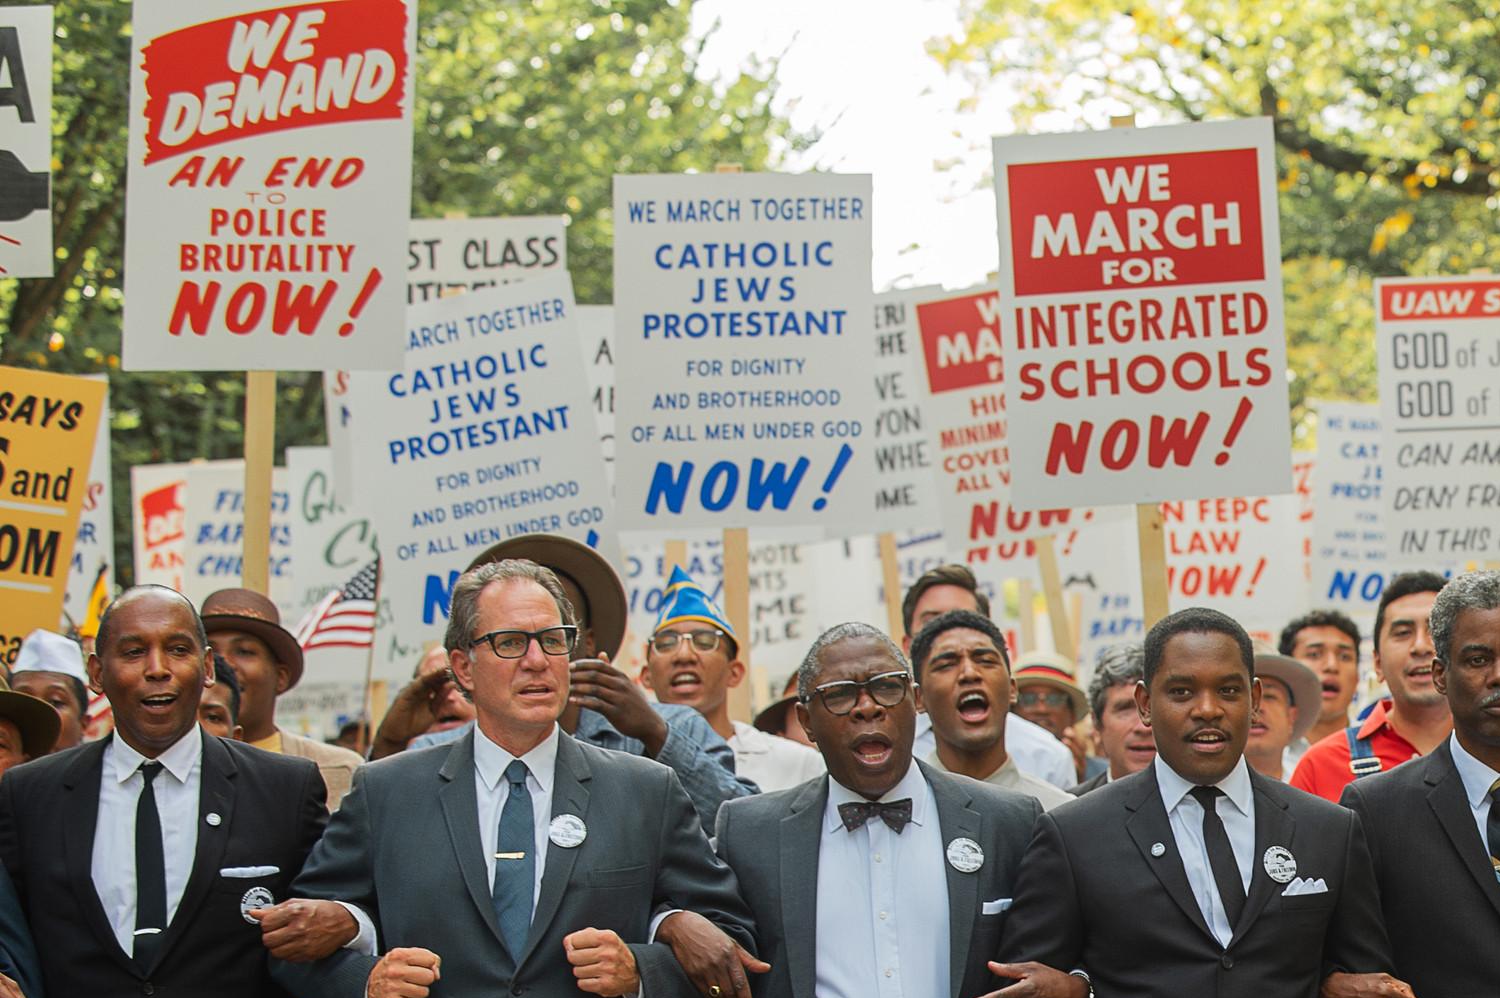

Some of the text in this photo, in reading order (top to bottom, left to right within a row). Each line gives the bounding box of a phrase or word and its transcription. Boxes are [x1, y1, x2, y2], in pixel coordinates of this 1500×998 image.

[227, 8, 325, 74] WE
[158, 48, 397, 147] DEMAND
[168, 156, 366, 189] AN END
[1094, 164, 1171, 204] WE
[246, 191, 287, 205] TO
[629, 198, 863, 223] WE MARCH TOGETHER
[210, 208, 327, 237] POLICE
[1031, 202, 1241, 259] MARCH
[179, 244, 355, 273] BRUTALITY
[463, 236, 560, 270] CLASS
[655, 241, 833, 270] CATHOLIC
[1102, 257, 1177, 285] FOR
[168, 267, 383, 338] NOW!
[692, 276, 796, 304] JEWS
[1390, 290, 1474, 316] UAW
[406, 298, 567, 349] ARCH TOGETHER
[643, 311, 847, 339] PROTESTANT
[1015, 292, 1269, 349] INTEGRATED
[686, 358, 806, 376] FOR DIGNITY
[1393, 332, 1449, 370] GOD
[1456, 339, 1480, 369] of
[388, 344, 548, 397] CATHOLIC
[1020, 348, 1272, 401] SCHOOLS
[430, 384, 520, 423] JEWS
[652, 390, 841, 410] AND BROTHERHOOD
[1397, 380, 1453, 419] GOD
[1467, 387, 1490, 417] of
[389, 406, 570, 464] PROTESTANT
[632, 421, 862, 443] OF ALL MEN UNDER GOD
[1045, 396, 1253, 476] NOW!
[943, 447, 1010, 473] COVE
[1397, 442, 1453, 468] CAN
[11, 467, 74, 503] and
[436, 457, 542, 492] FOR DIGNITY
[644, 443, 853, 515] NOW!
[412, 480, 579, 528] AND BROTHERHOOD
[1199, 498, 1270, 523] FEPC
[1393, 484, 1458, 511] DENY
[397, 543, 419, 562] OF
[427, 535, 458, 556] ALL
[464, 525, 500, 548] MEN
[506, 513, 562, 539] UNDER
[567, 506, 604, 527] GOD
[1169, 531, 1240, 555] LAW
[1400, 528, 1428, 554] IN
[1435, 526, 1491, 553] THIS
[1168, 557, 1267, 597] OW!
